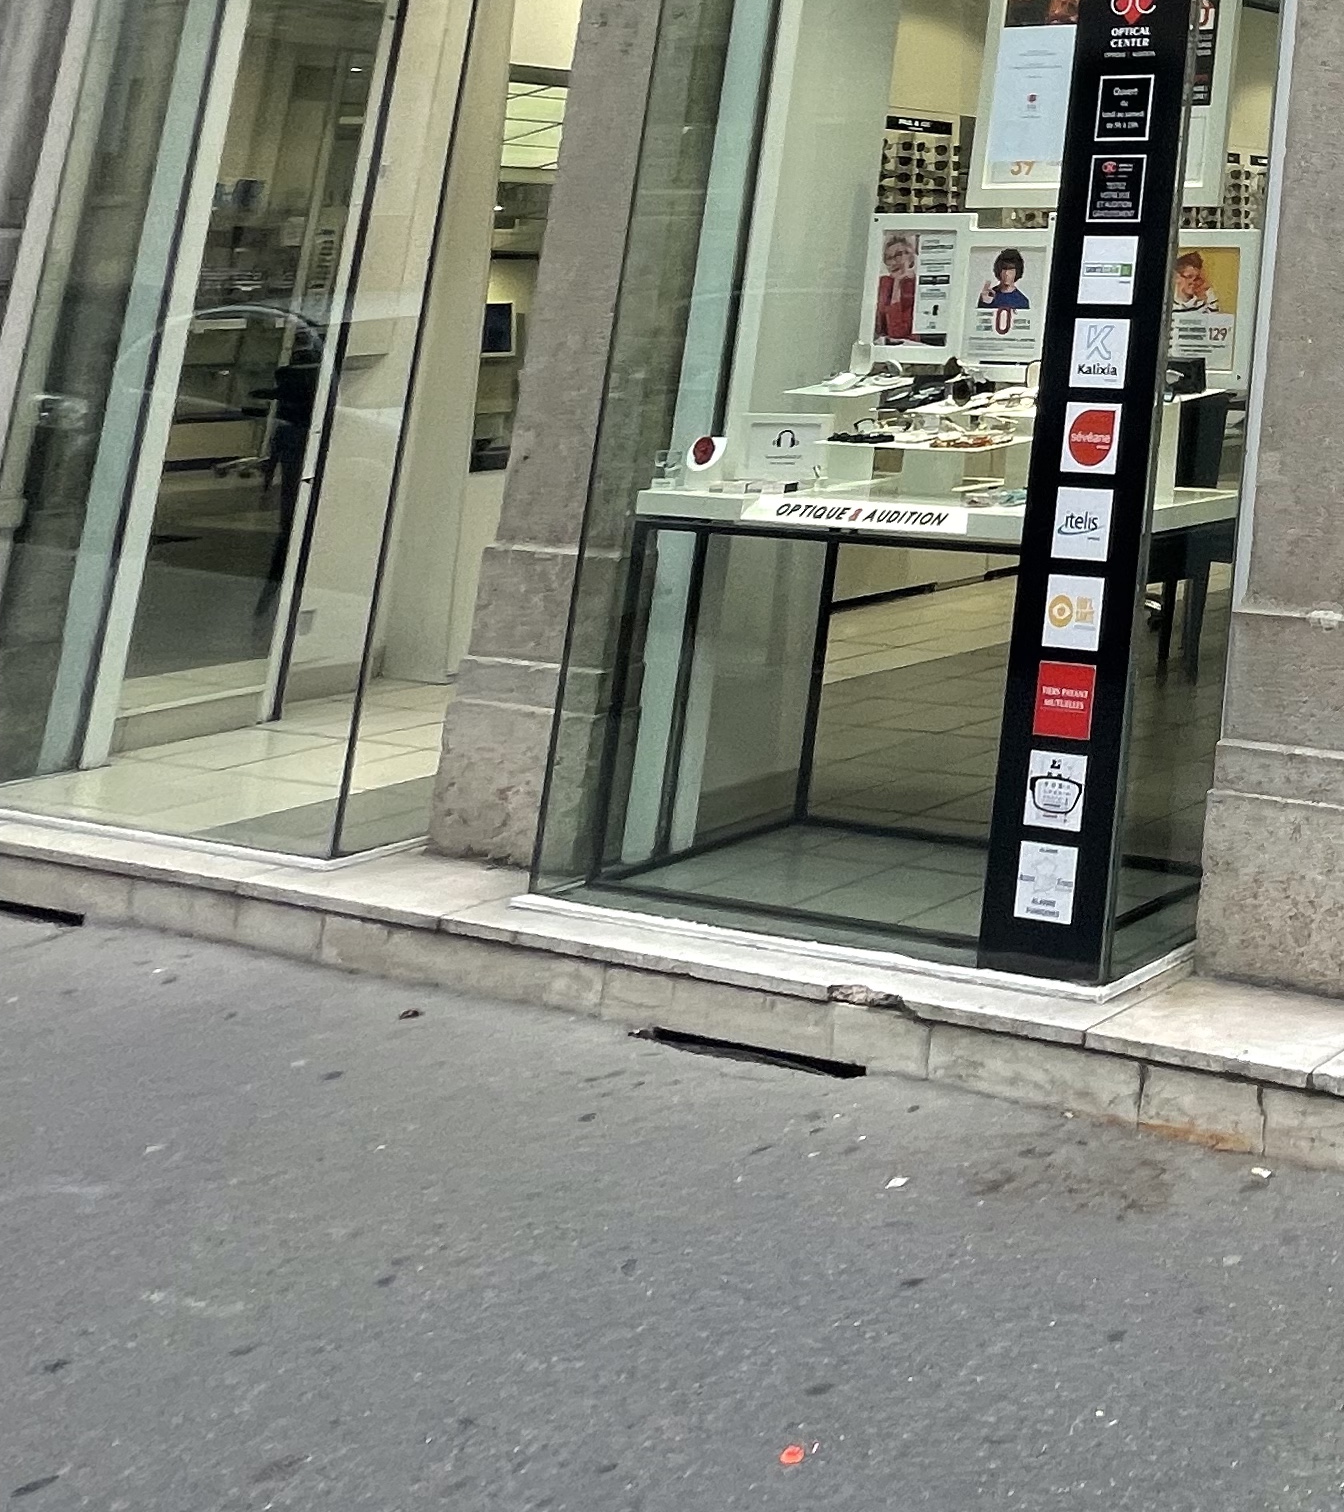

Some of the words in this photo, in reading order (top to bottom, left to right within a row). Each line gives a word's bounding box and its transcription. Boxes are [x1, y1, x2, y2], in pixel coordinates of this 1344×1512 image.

[1110, 26, 1151, 37] OPTICAL
[1110, 38, 1150, 48] CENTER
[1077, 363, 1118, 376] Kalixia
[776, 503, 851, 521] OPTIQUE
[861, 508, 949, 526] AUDITION
